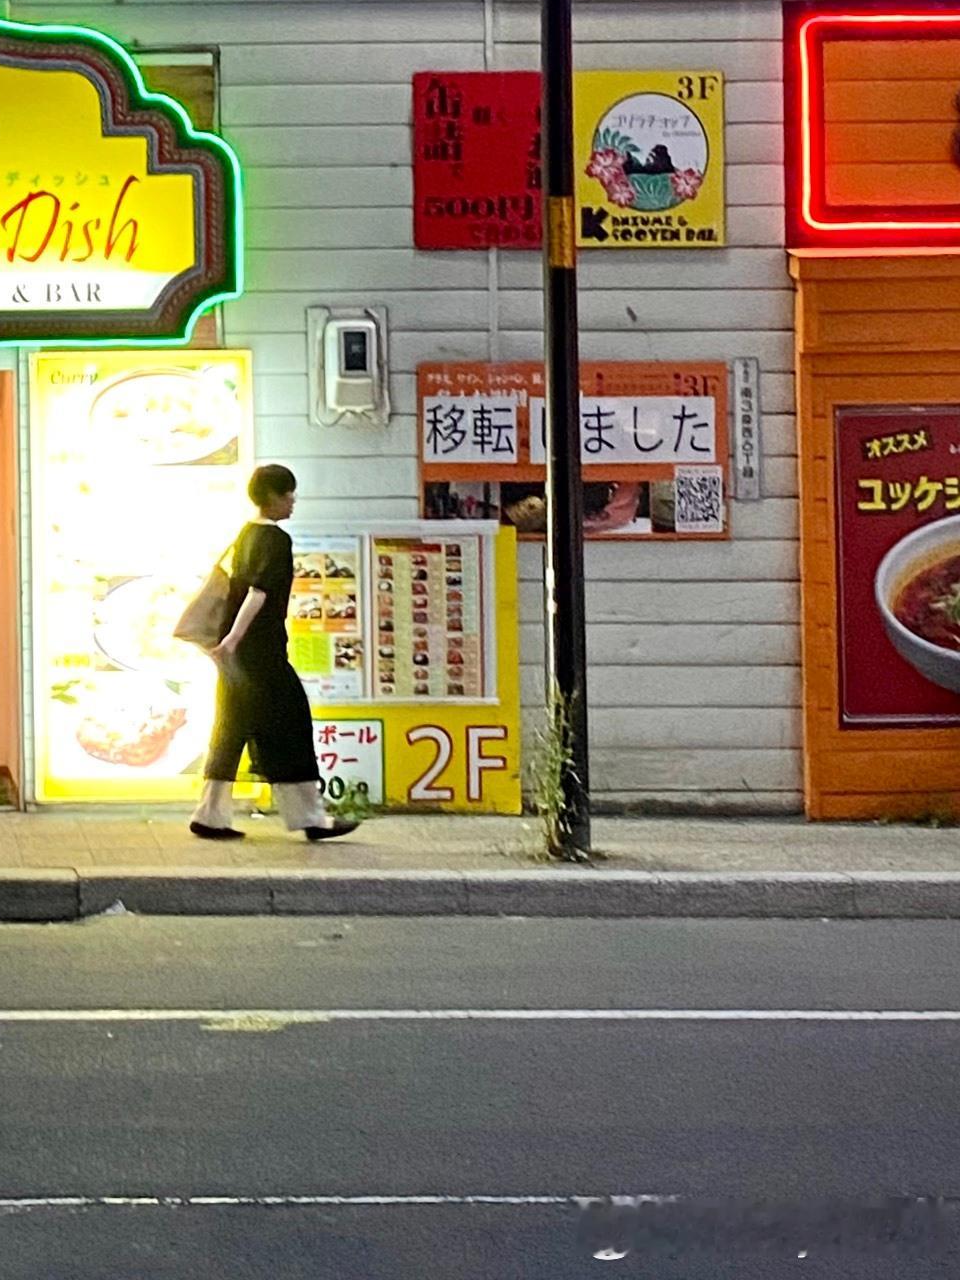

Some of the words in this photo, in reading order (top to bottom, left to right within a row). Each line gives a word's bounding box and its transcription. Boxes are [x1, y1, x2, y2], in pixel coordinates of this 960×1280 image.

[678, 76, 719, 100] 3F
[5, 172, 111, 187] ディッシュ
[0, 175, 140, 264] Dish
[12, 283, 31, 303] &
[45, 282, 102, 303] BAR
[426, 403, 711, 455] 移転ました
[865, 429, 928, 459] オススメ
[318, 726, 378, 745] ボール
[316, 752, 359, 770] ワー
[405, 723, 509, 803] 2F
